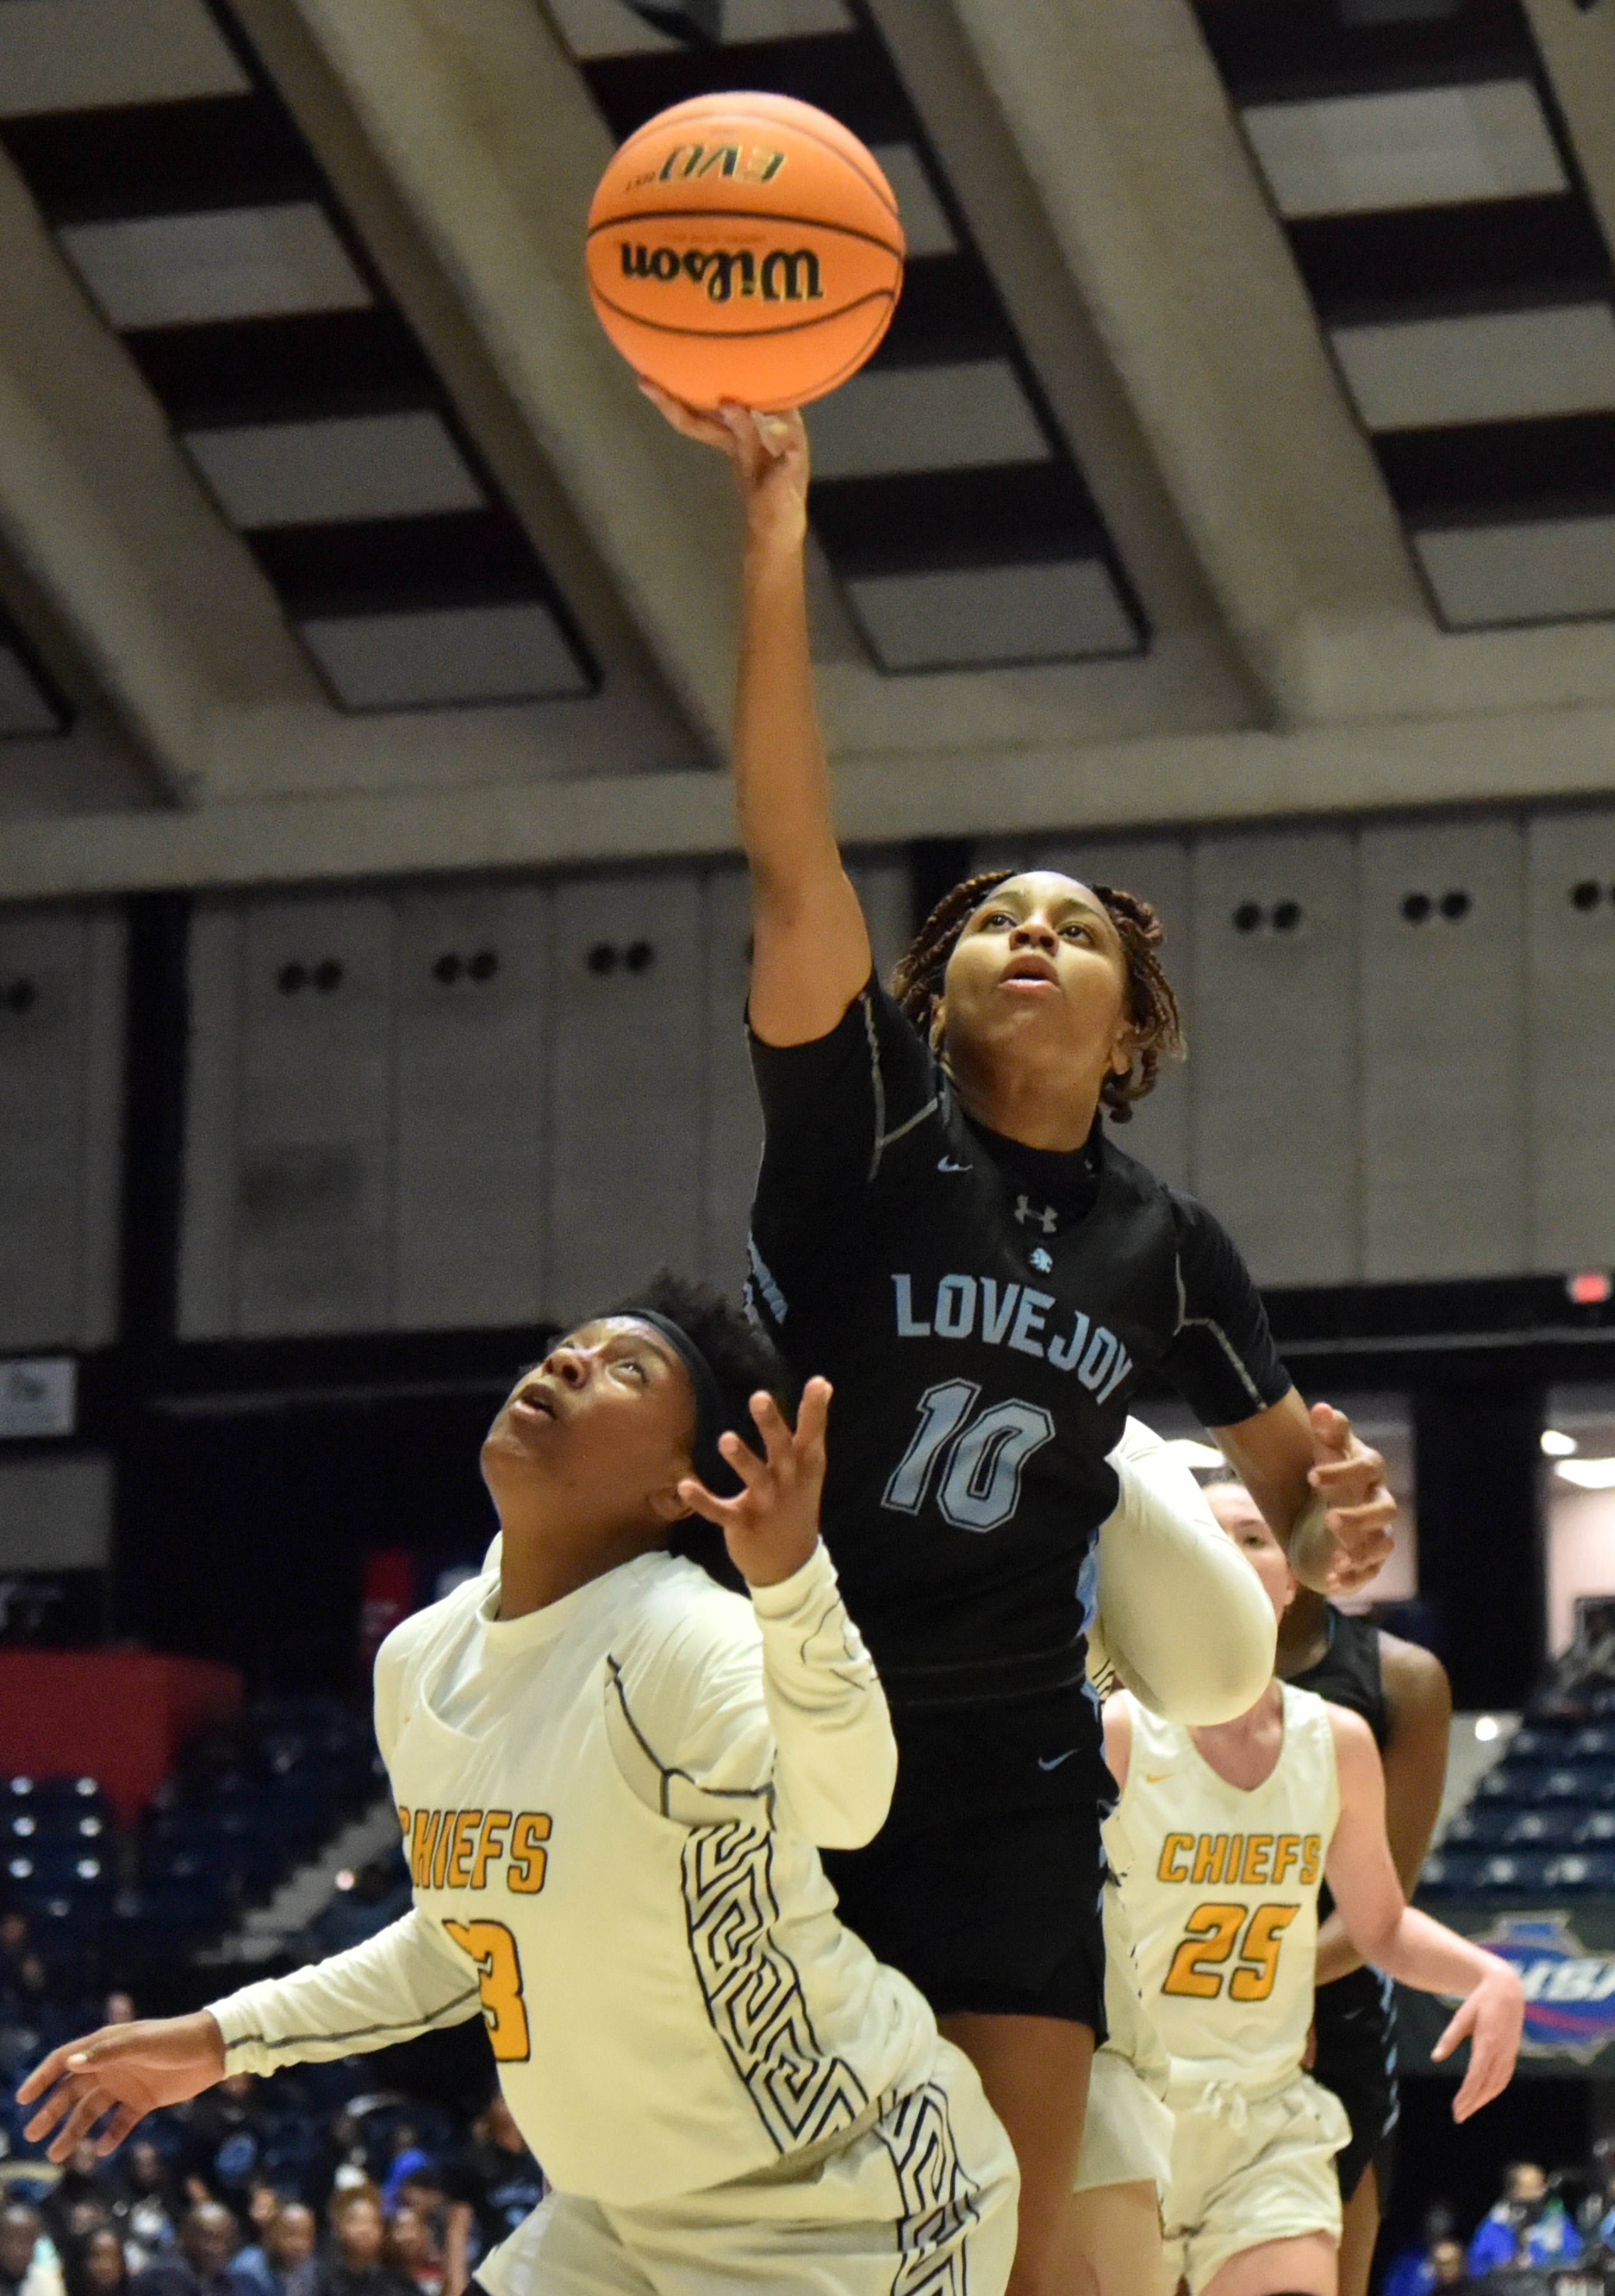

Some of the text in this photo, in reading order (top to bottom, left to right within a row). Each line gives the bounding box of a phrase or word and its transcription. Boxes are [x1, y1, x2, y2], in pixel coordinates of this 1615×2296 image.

[657, 141, 788, 185] EVO
[620, 241, 824, 304] Wilson
[891, 1274, 1133, 1405] LOVEJOY
[880, 1377, 1056, 1533] 10
[1157, 1833, 1321, 1884] CHIEFS
[1161, 1902, 1301, 2002] 25
